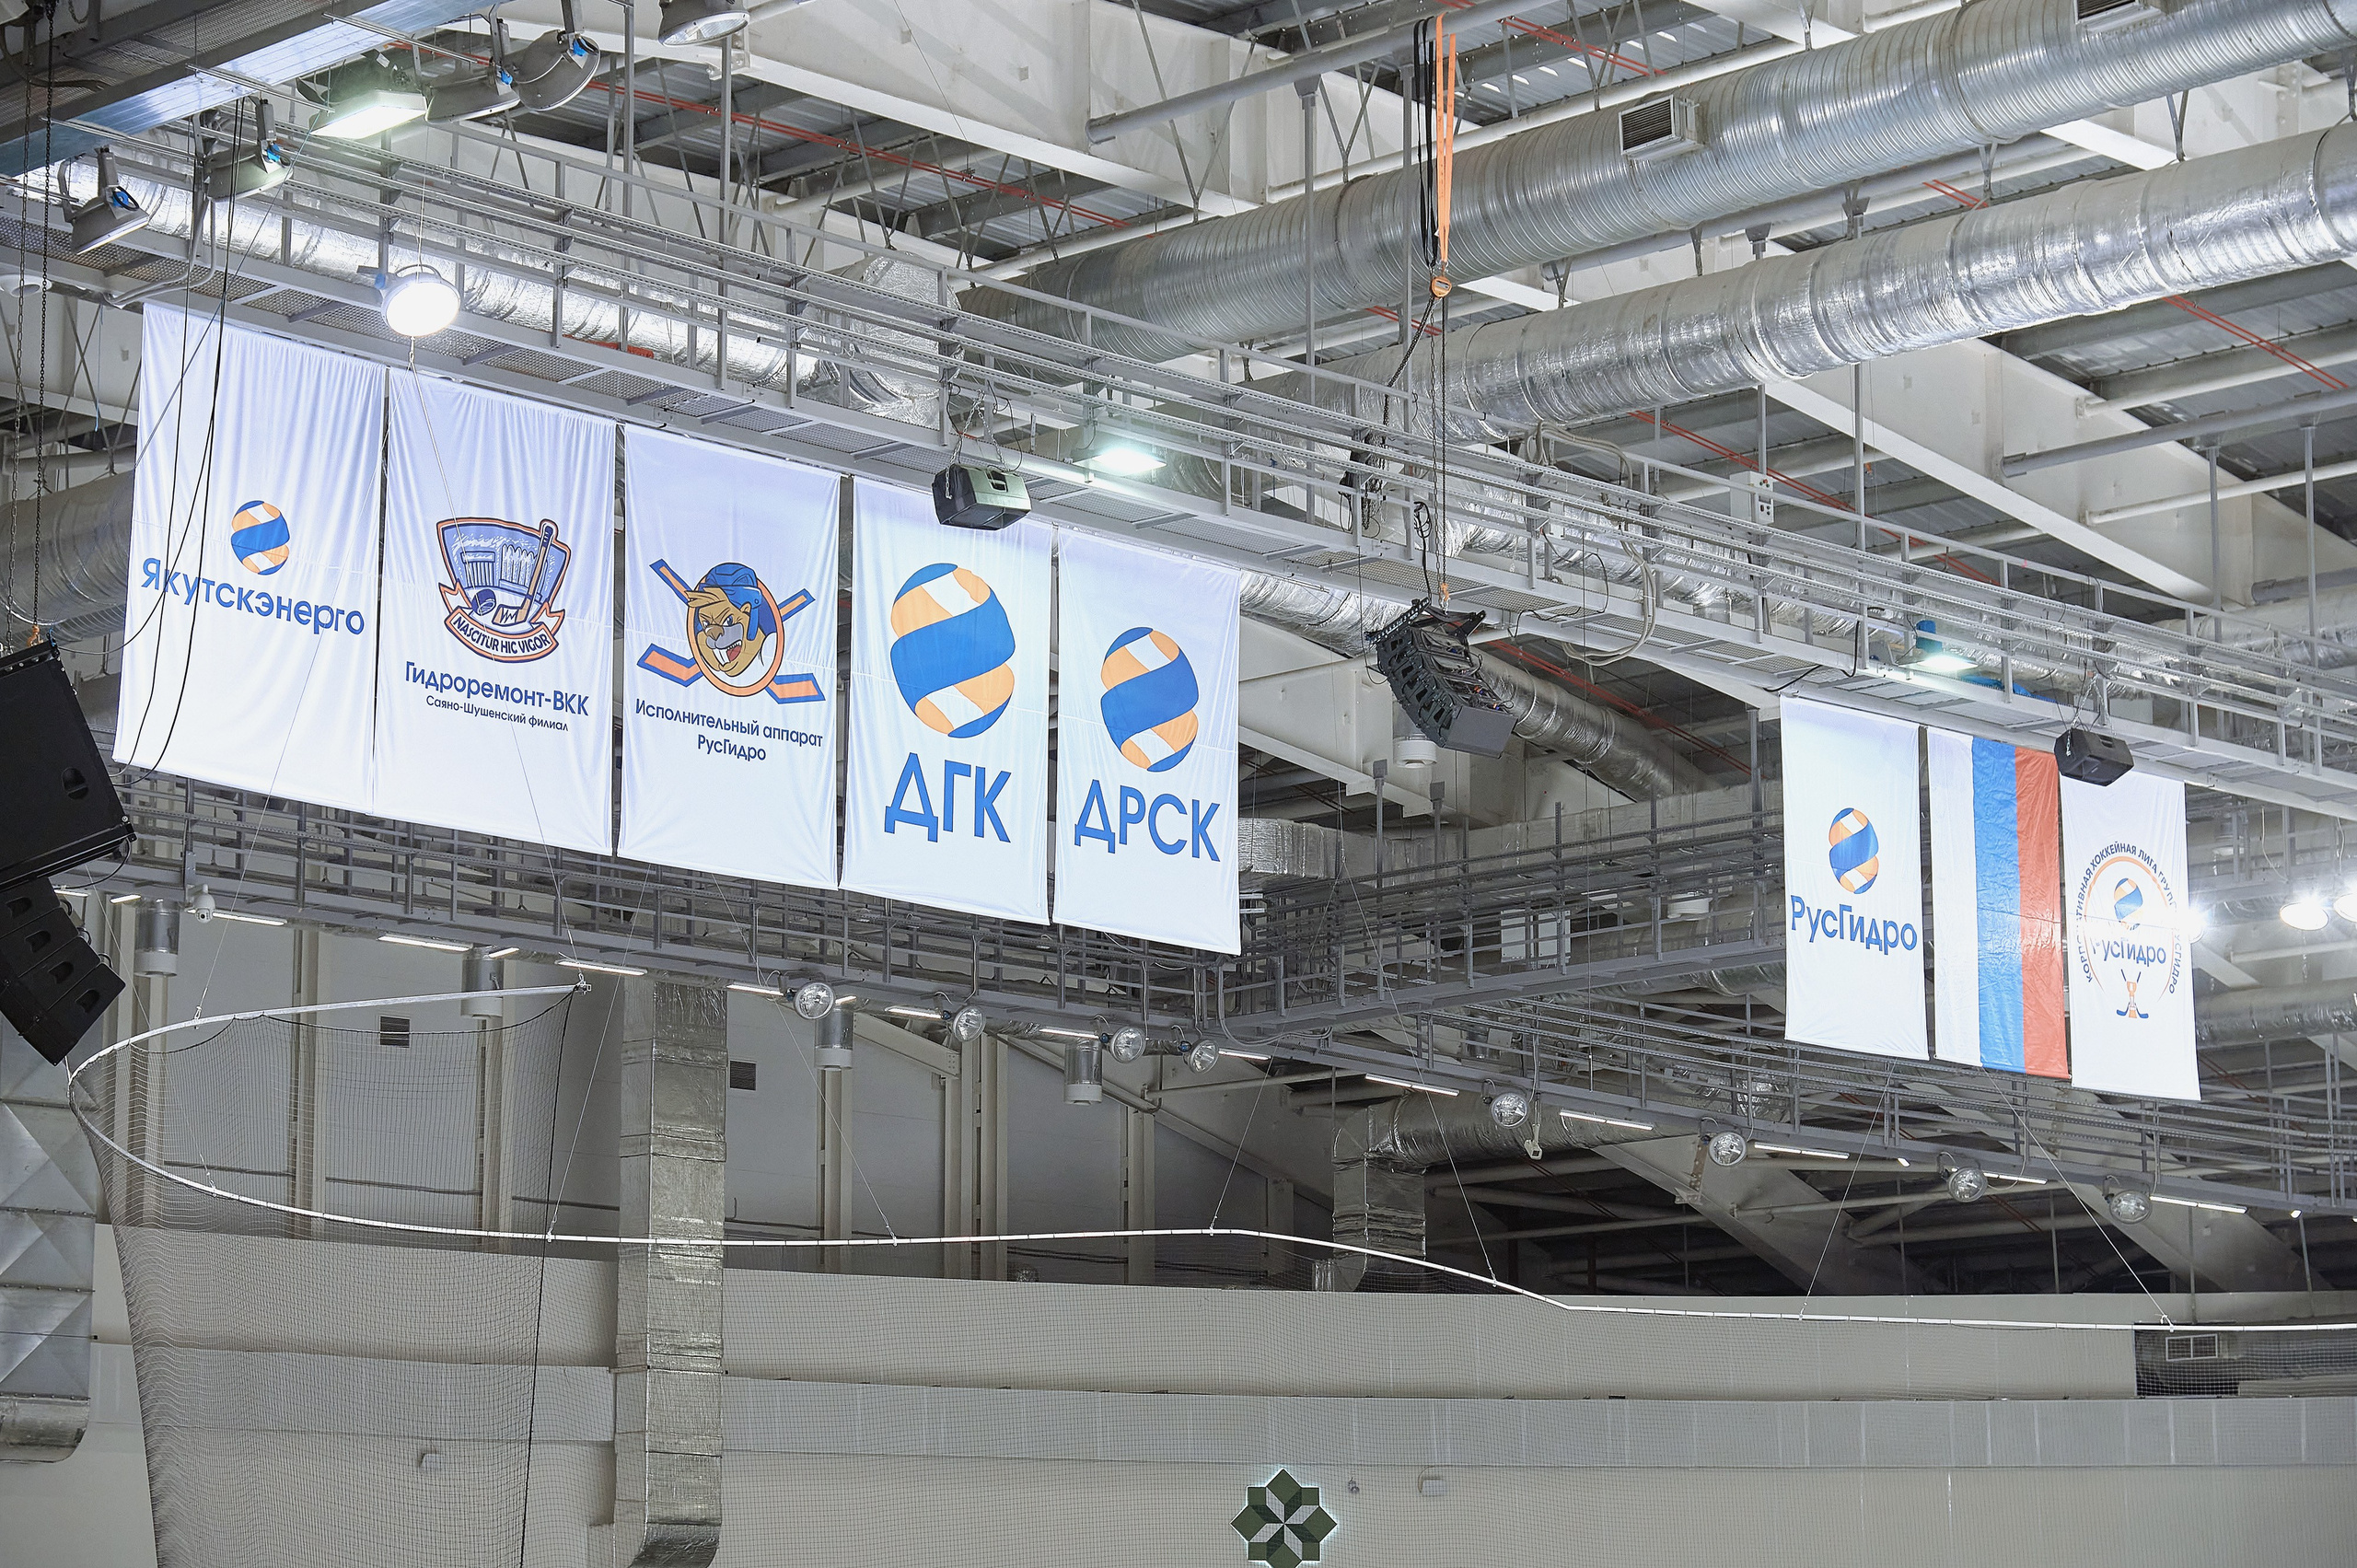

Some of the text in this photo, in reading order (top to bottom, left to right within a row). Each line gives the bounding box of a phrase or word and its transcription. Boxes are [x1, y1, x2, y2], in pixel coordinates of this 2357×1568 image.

[141, 557, 365, 635] Якутскэнерго
[452, 616, 552, 655] NASCITUR HIC VIGOR
[405, 660, 589, 717] Гидроремонт-ВКК
[425, 694, 569, 732] Саяно-Шушенский филиал
[635, 698, 824, 748] Исполнительный аппарат
[697, 734, 767, 762] РусГидро
[884, 751, 1012, 843] ДГК
[1074, 778, 1221, 863] ДРСК
[1790, 894, 1918, 956] РусГидро
[2089, 840, 2137, 872] ХОККЕЙНАЯ
[2138, 849, 2158, 875] ЛИГА
[2168, 927, 2183, 994] УСГИДРО
